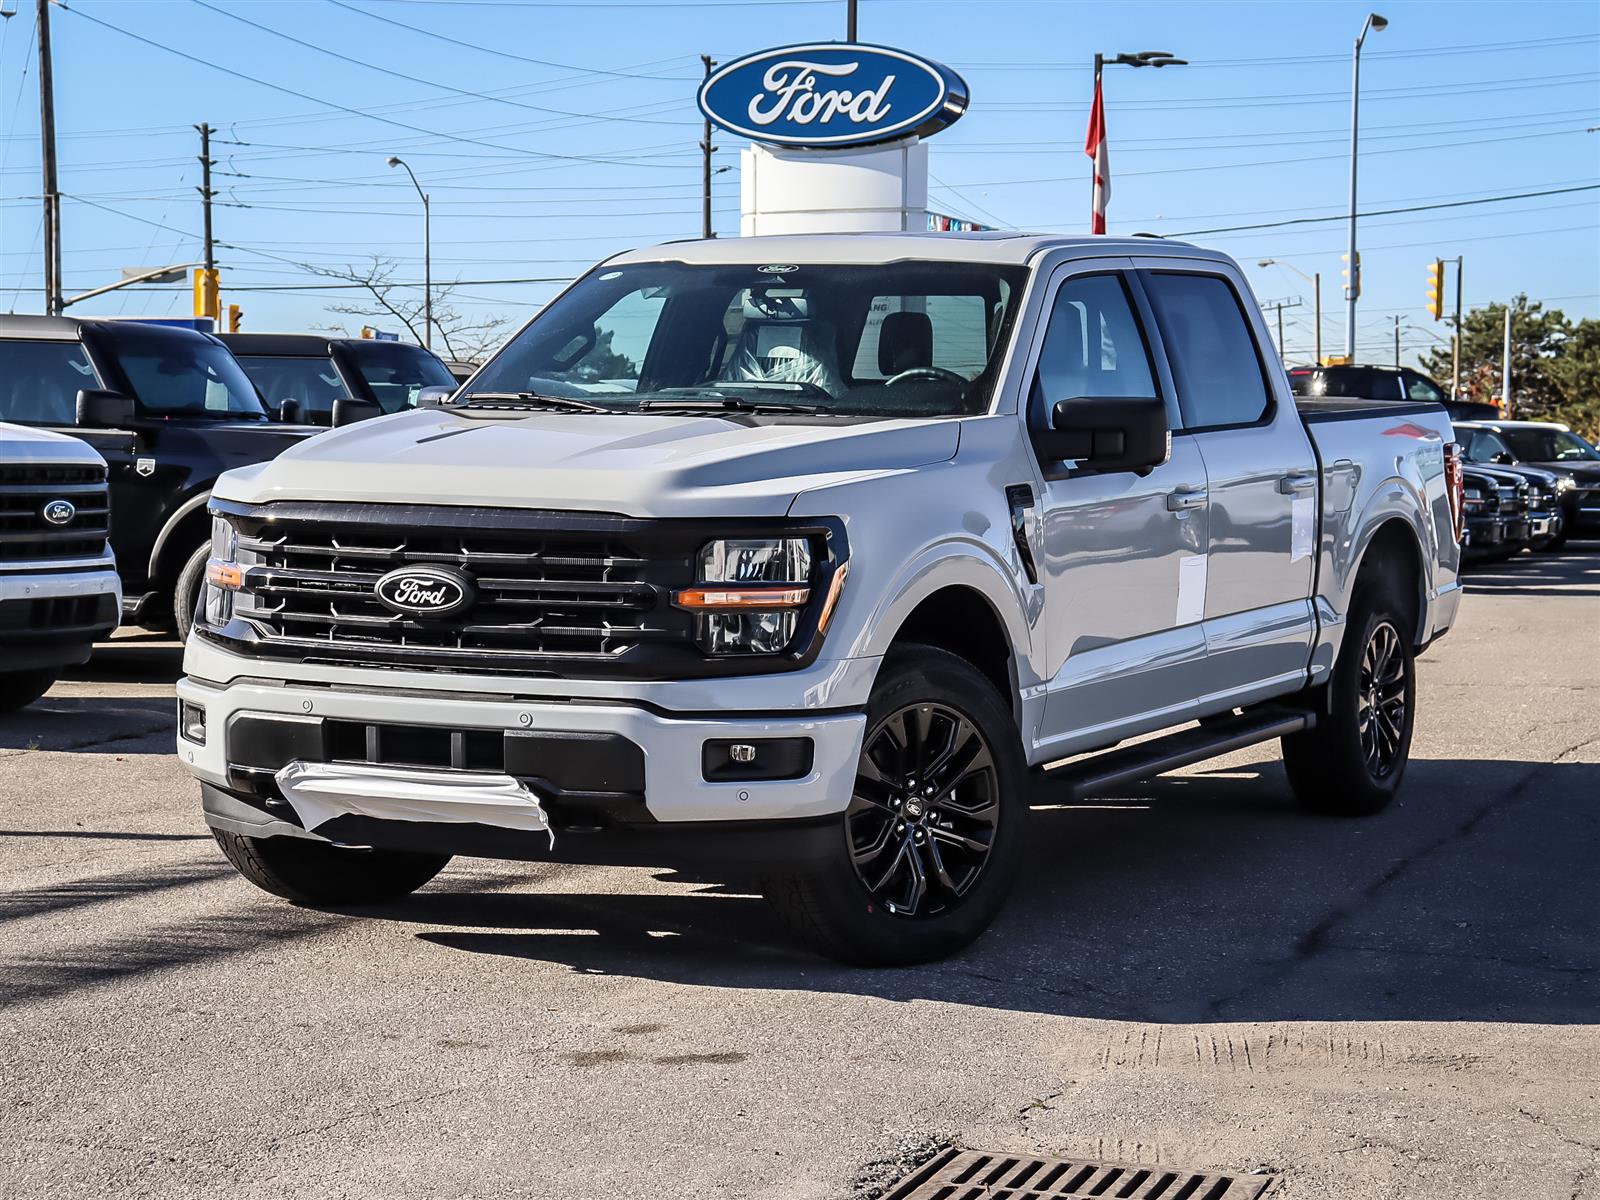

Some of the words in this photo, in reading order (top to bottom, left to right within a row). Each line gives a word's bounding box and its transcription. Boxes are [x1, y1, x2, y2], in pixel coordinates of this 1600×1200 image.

[748, 61, 896, 124] Ford
[52, 505, 70, 519] Ford
[394, 578, 447, 605] Ford
